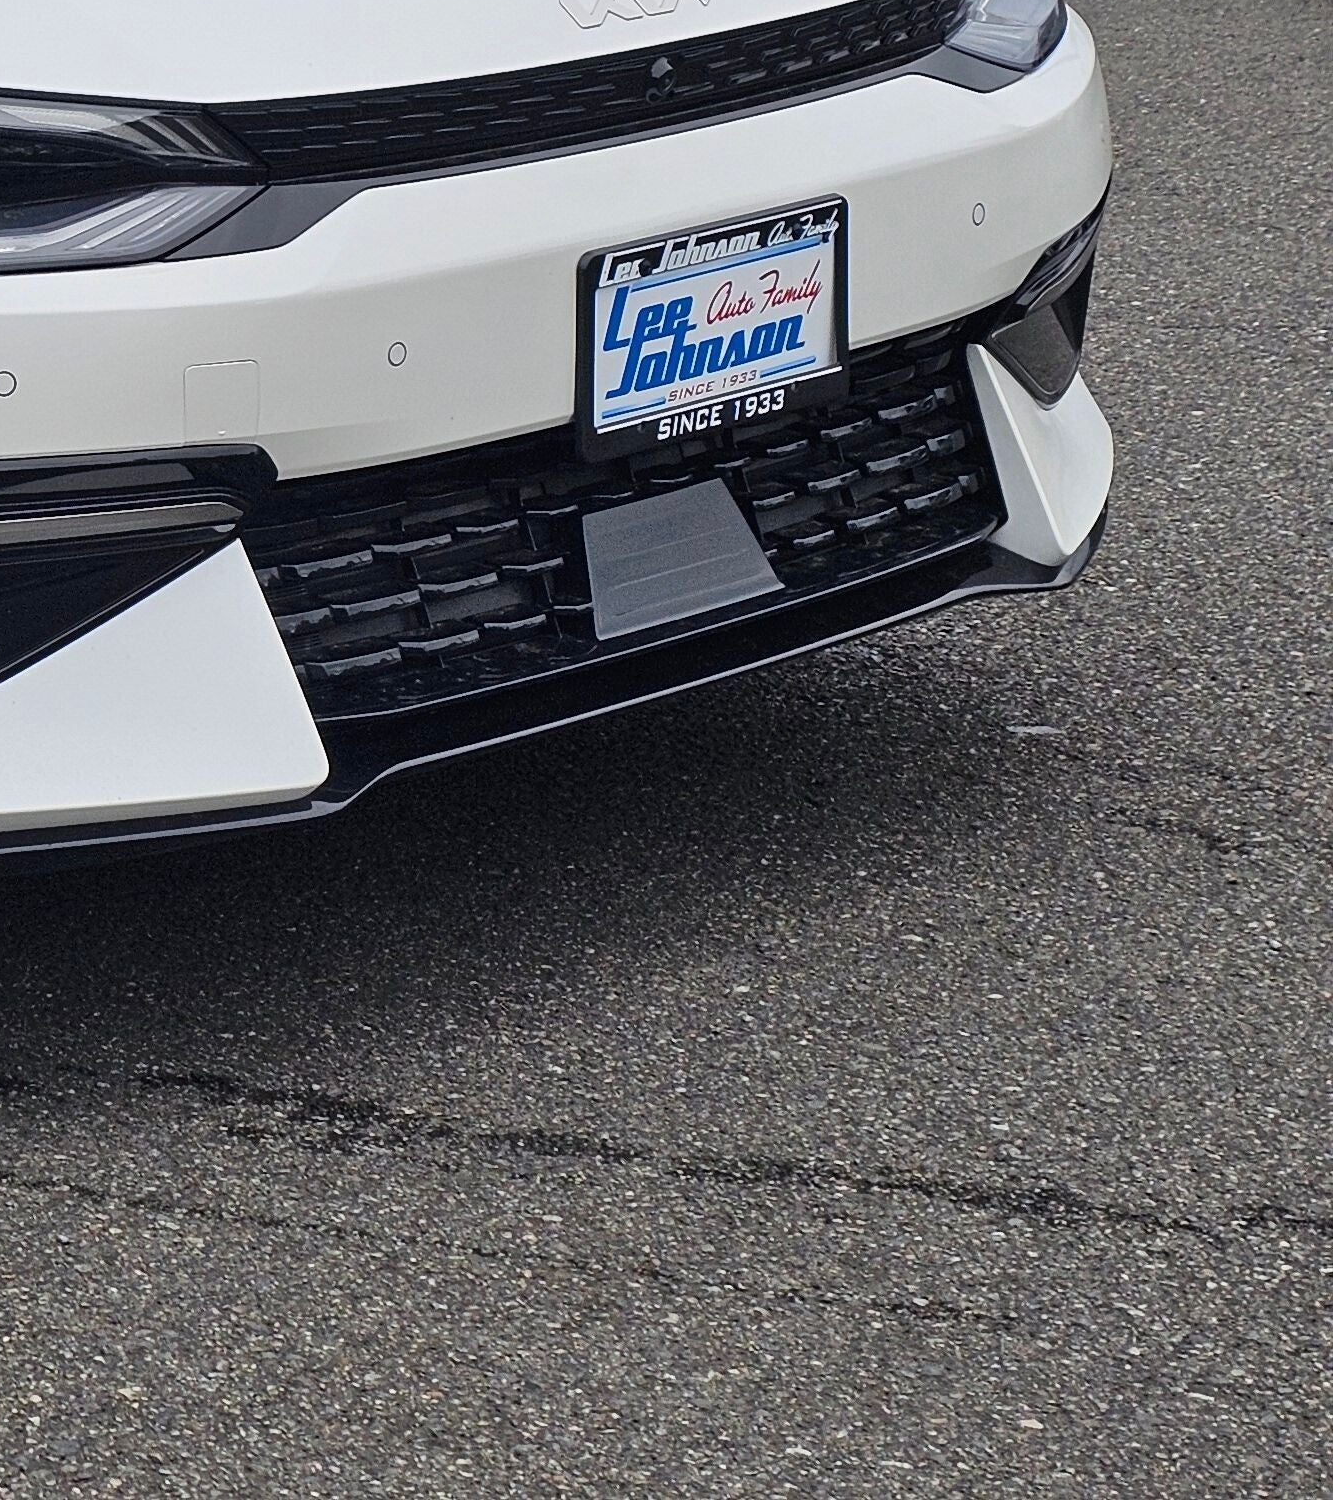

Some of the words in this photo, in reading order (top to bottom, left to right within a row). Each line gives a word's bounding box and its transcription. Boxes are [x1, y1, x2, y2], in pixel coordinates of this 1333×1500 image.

[652, 234, 761, 274] Johnson
[603, 285, 697, 351] Lee
[707, 281, 756, 325] Auto
[759, 259, 822, 315] Family
[605, 314, 805, 400] Johnson
[668, 381, 715, 402] SINCE
[722, 369, 758, 389] 1933
[657, 404, 724, 440] SINCE
[734, 389, 785, 420] 1933
